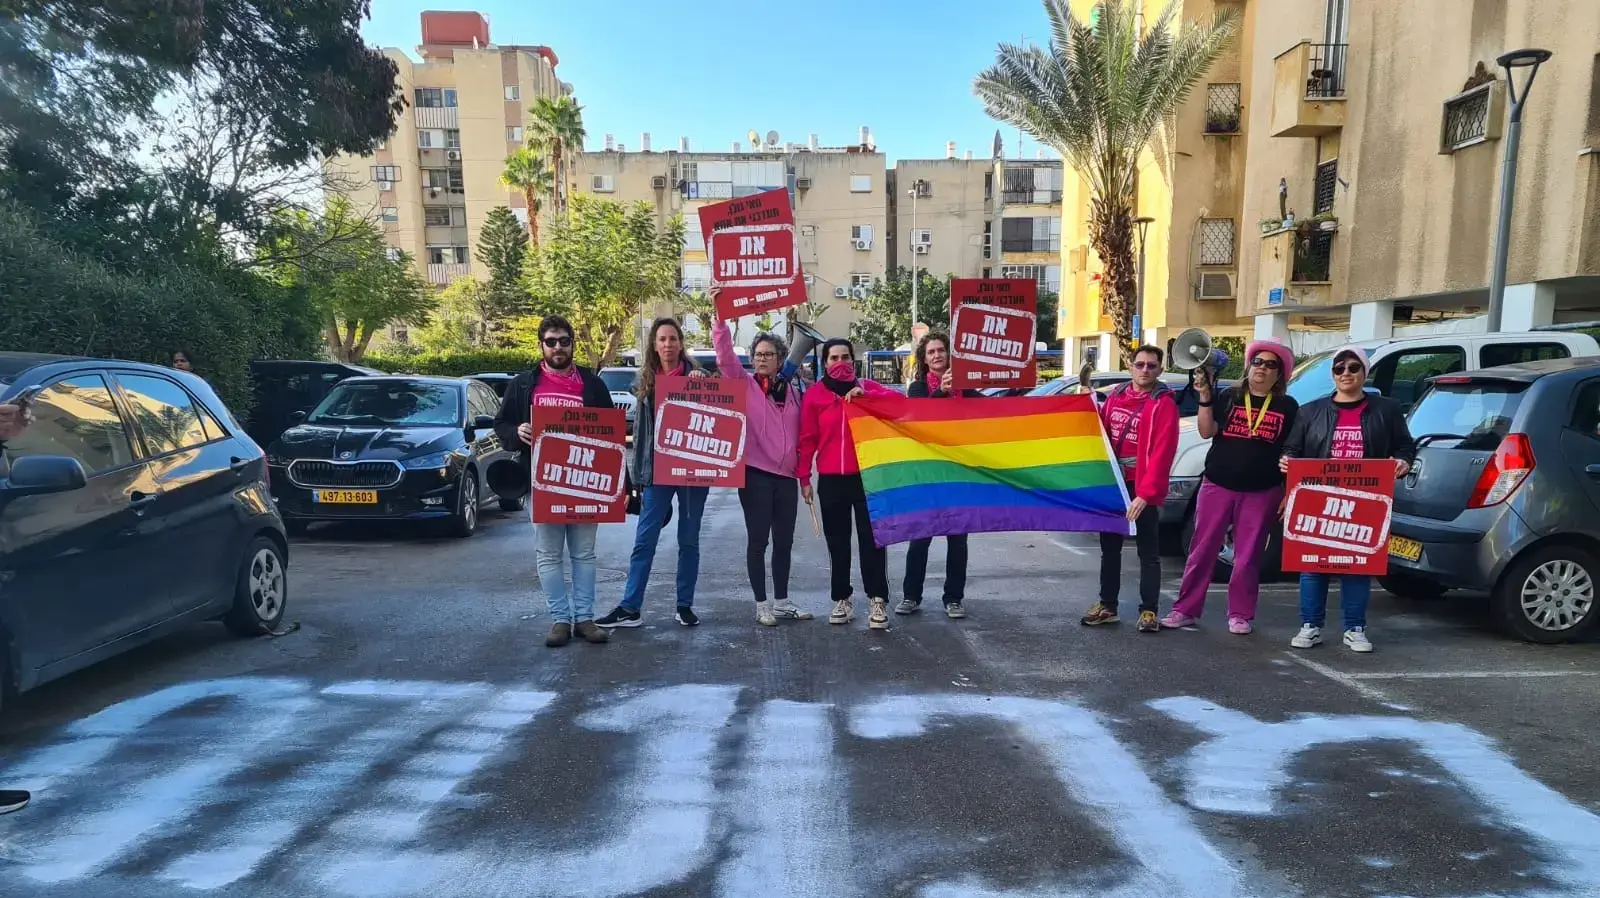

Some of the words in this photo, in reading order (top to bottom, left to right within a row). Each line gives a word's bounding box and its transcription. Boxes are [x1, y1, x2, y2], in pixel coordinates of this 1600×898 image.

[740, 236, 765, 255] את
[720, 258, 787, 277] מפוטרת!
[778, 288, 789, 298] על
[982, 314, 1008, 336] את
[960, 332, 1023, 358] מפוטרת!
[1011, 370, 1020, 378] על
[688, 412, 716, 434] את
[664, 428, 732, 458] מפוטרת!
[567, 445, 595, 468] את
[542, 463, 612, 492] מפוטרת!
[719, 468, 728, 477] על
[599, 504, 608, 513] על
[1323, 497, 1356, 519] את
[1294, 514, 1373, 544] מפוטרת!
[1356, 555, 1367, 564] על
